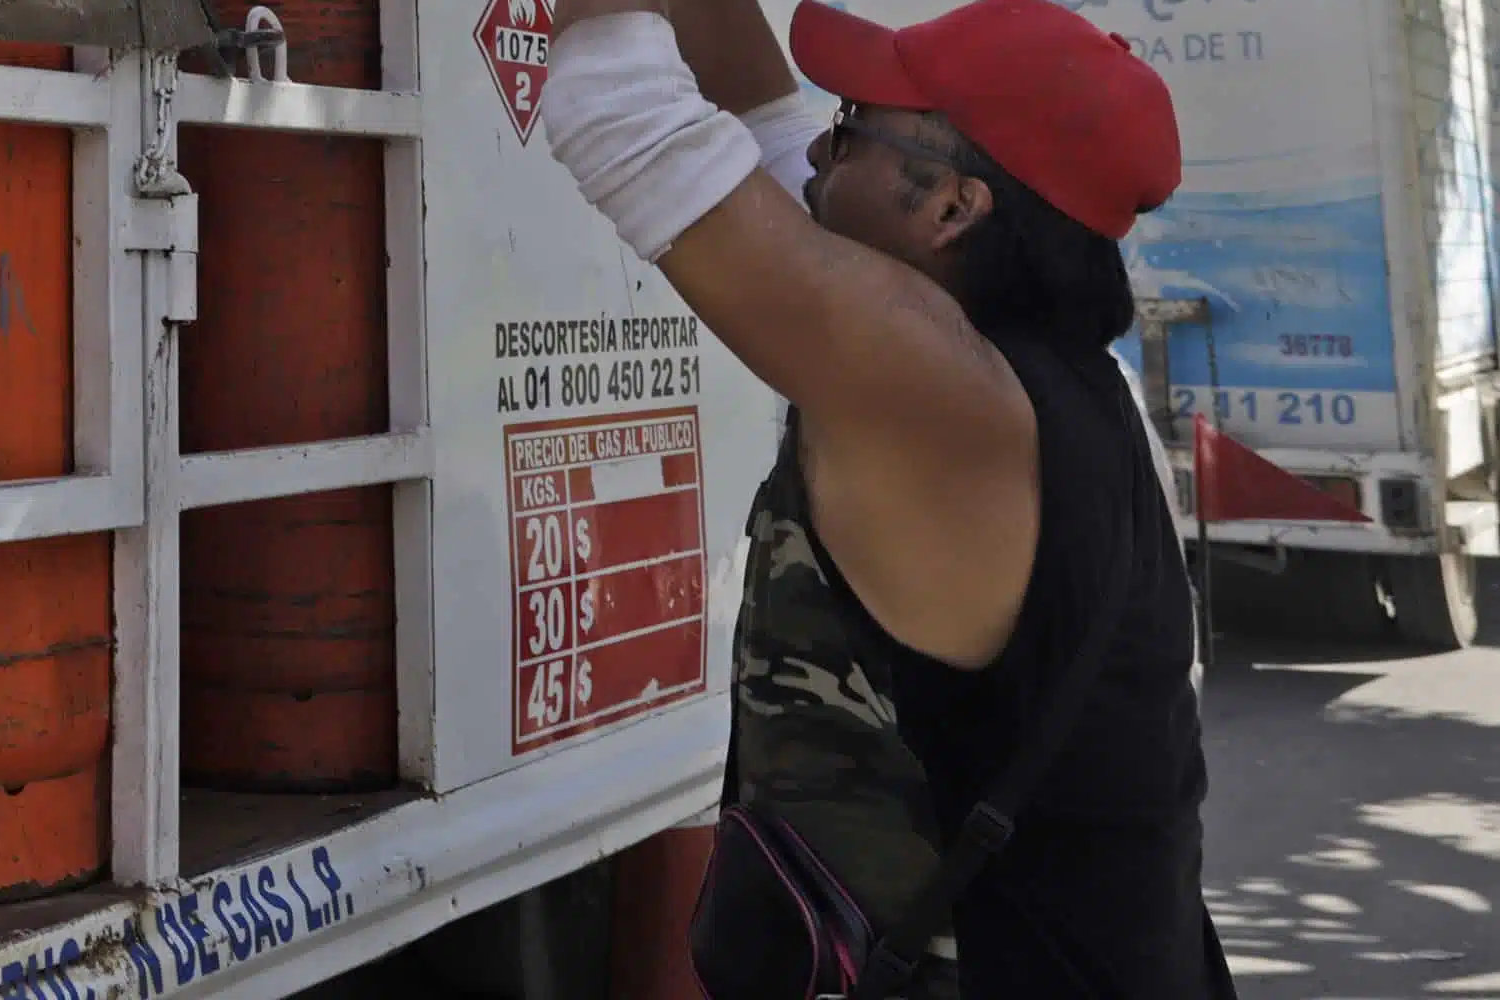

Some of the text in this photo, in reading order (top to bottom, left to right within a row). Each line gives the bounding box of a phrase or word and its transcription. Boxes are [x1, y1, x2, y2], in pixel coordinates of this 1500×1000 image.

[497, 30, 547, 64] 1075
[1184, 32, 1225, 61] DE
[1238, 31, 1264, 61] TI
[515, 71, 531, 111] 2
[495, 312, 698, 358] DESCORTESÍA REPORTAR
[497, 355, 701, 413] AL 01 800 450 22 51
[1277, 392, 1356, 425] 210
[515, 421, 693, 470] PRECIO DEL GAS AL PUBLICO
[521, 475, 560, 508] KGS.
[526, 514, 591, 581] 20 $
[528, 587, 594, 655] 30 $
[527, 658, 592, 727] 45 $
[156, 892, 220, 986] DE
[212, 864, 294, 962] GAS
[287, 846, 354, 932] L.P.
